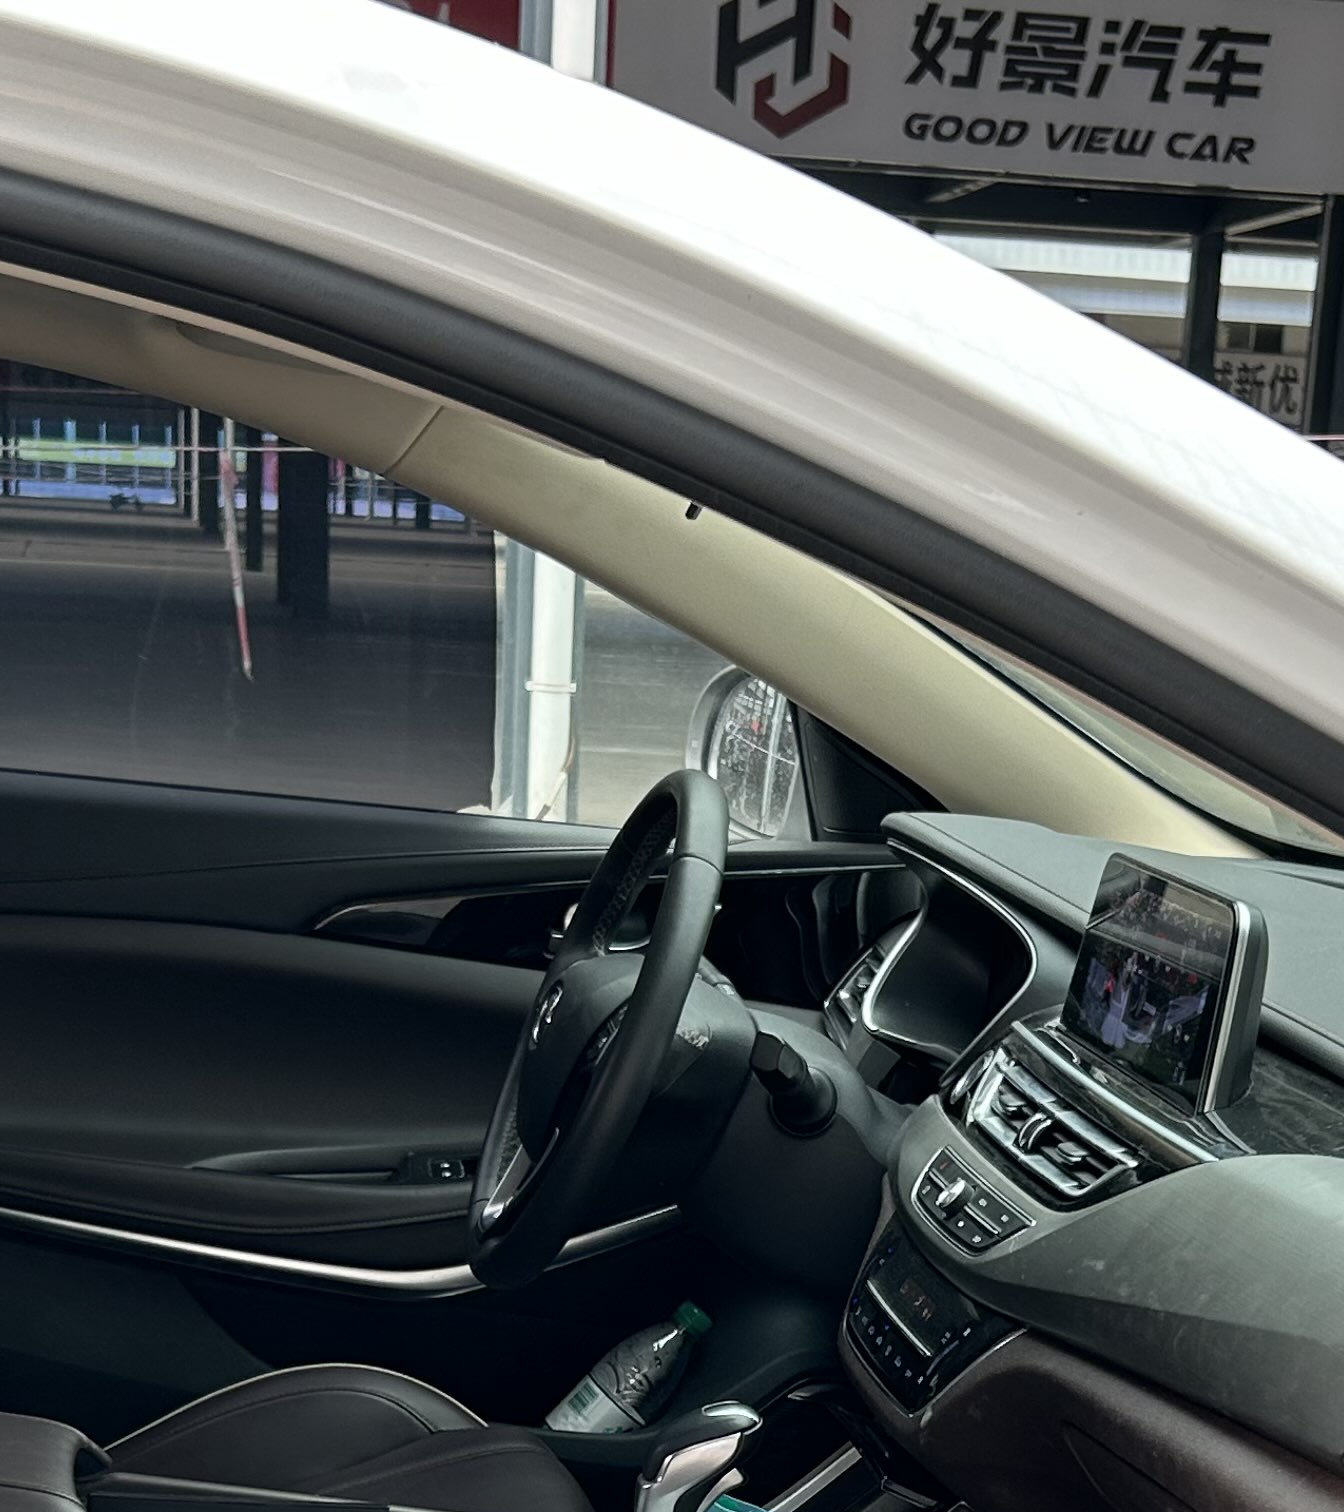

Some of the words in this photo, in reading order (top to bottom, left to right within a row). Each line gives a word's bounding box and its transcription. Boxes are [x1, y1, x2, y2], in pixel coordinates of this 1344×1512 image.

[904, 3, 1272, 107] 好景汽车
[902, 113, 1029, 147] GOOD
[1045, 122, 1156, 158] VIEW
[1164, 132, 1256, 164] CAR
